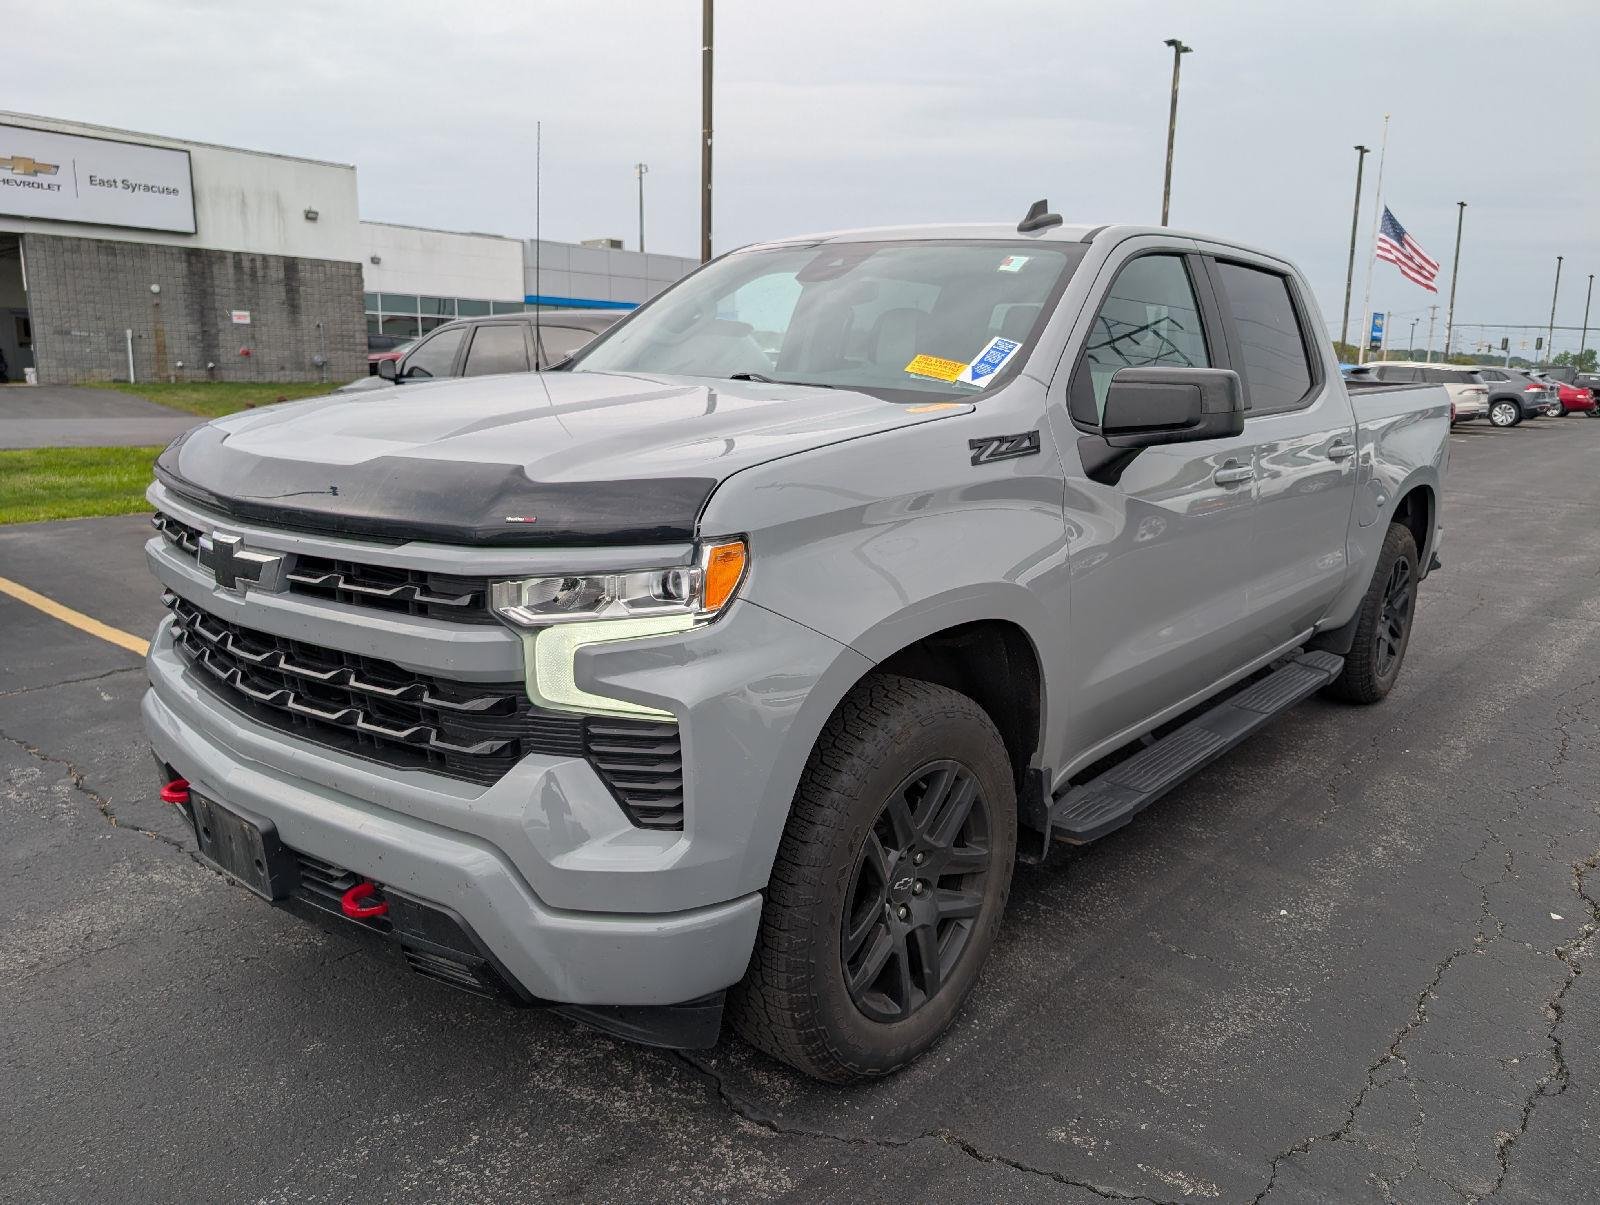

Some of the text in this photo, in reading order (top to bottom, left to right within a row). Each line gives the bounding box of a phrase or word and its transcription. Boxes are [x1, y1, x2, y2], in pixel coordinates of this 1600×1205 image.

[0, 178, 61, 192] HEVROLET
[89, 175, 179, 196] East Syracuse
[969, 430, 1040, 466] Z71
